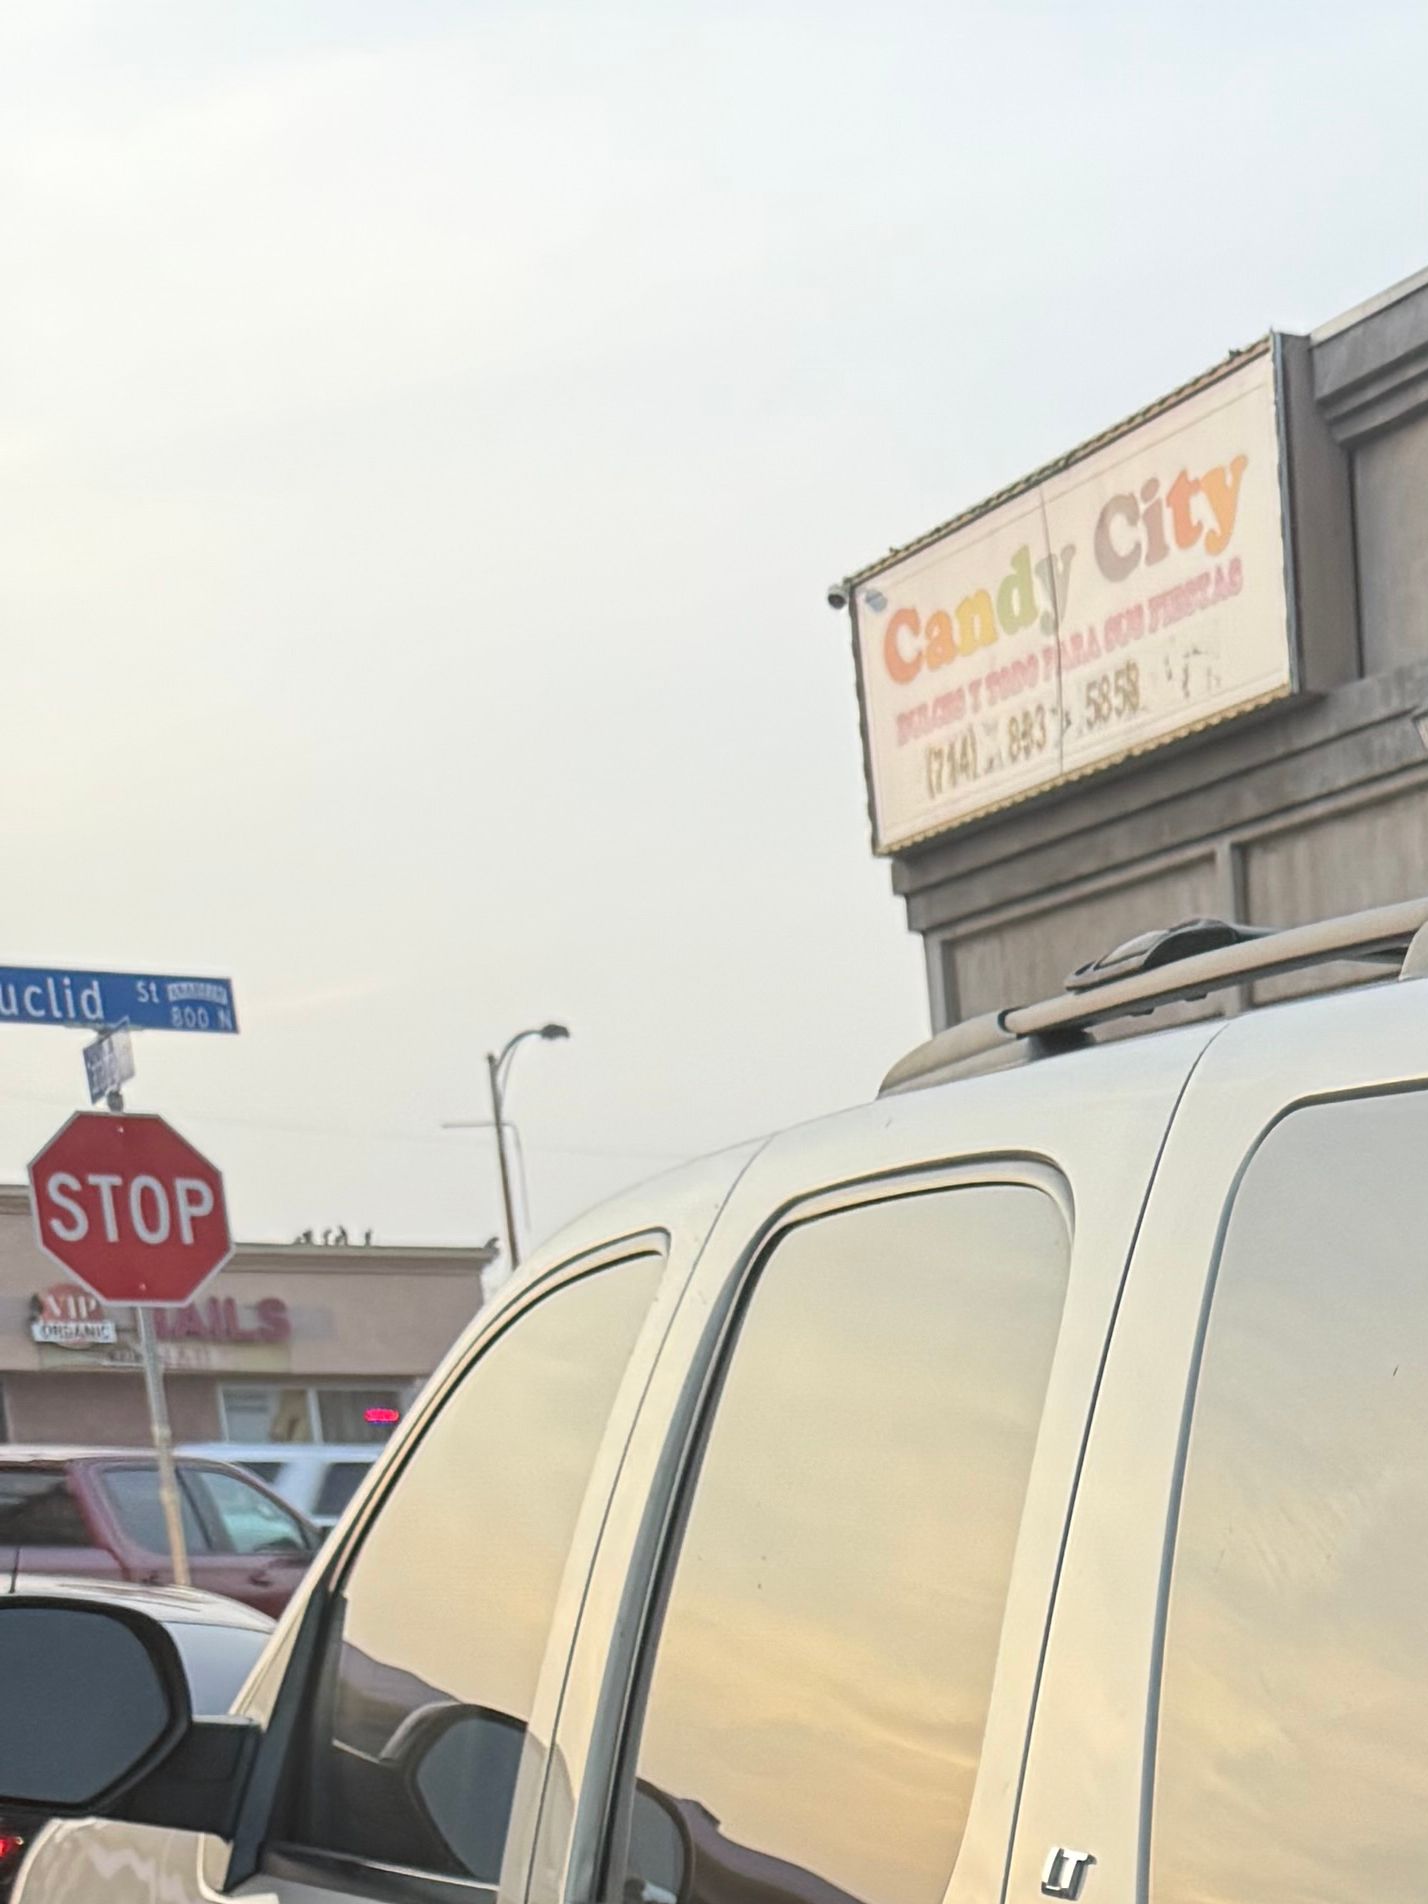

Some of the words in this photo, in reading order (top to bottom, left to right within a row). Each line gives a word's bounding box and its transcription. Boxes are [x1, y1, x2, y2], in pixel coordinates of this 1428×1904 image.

[884, 543, 1077, 685] Candy
[1094, 453, 1249, 583] City
[136, 980, 160, 1003] St
[171, 1006, 210, 1029] 800
[47, 1171, 214, 1245] STOP
[1041, 1847, 1098, 1901] LT
